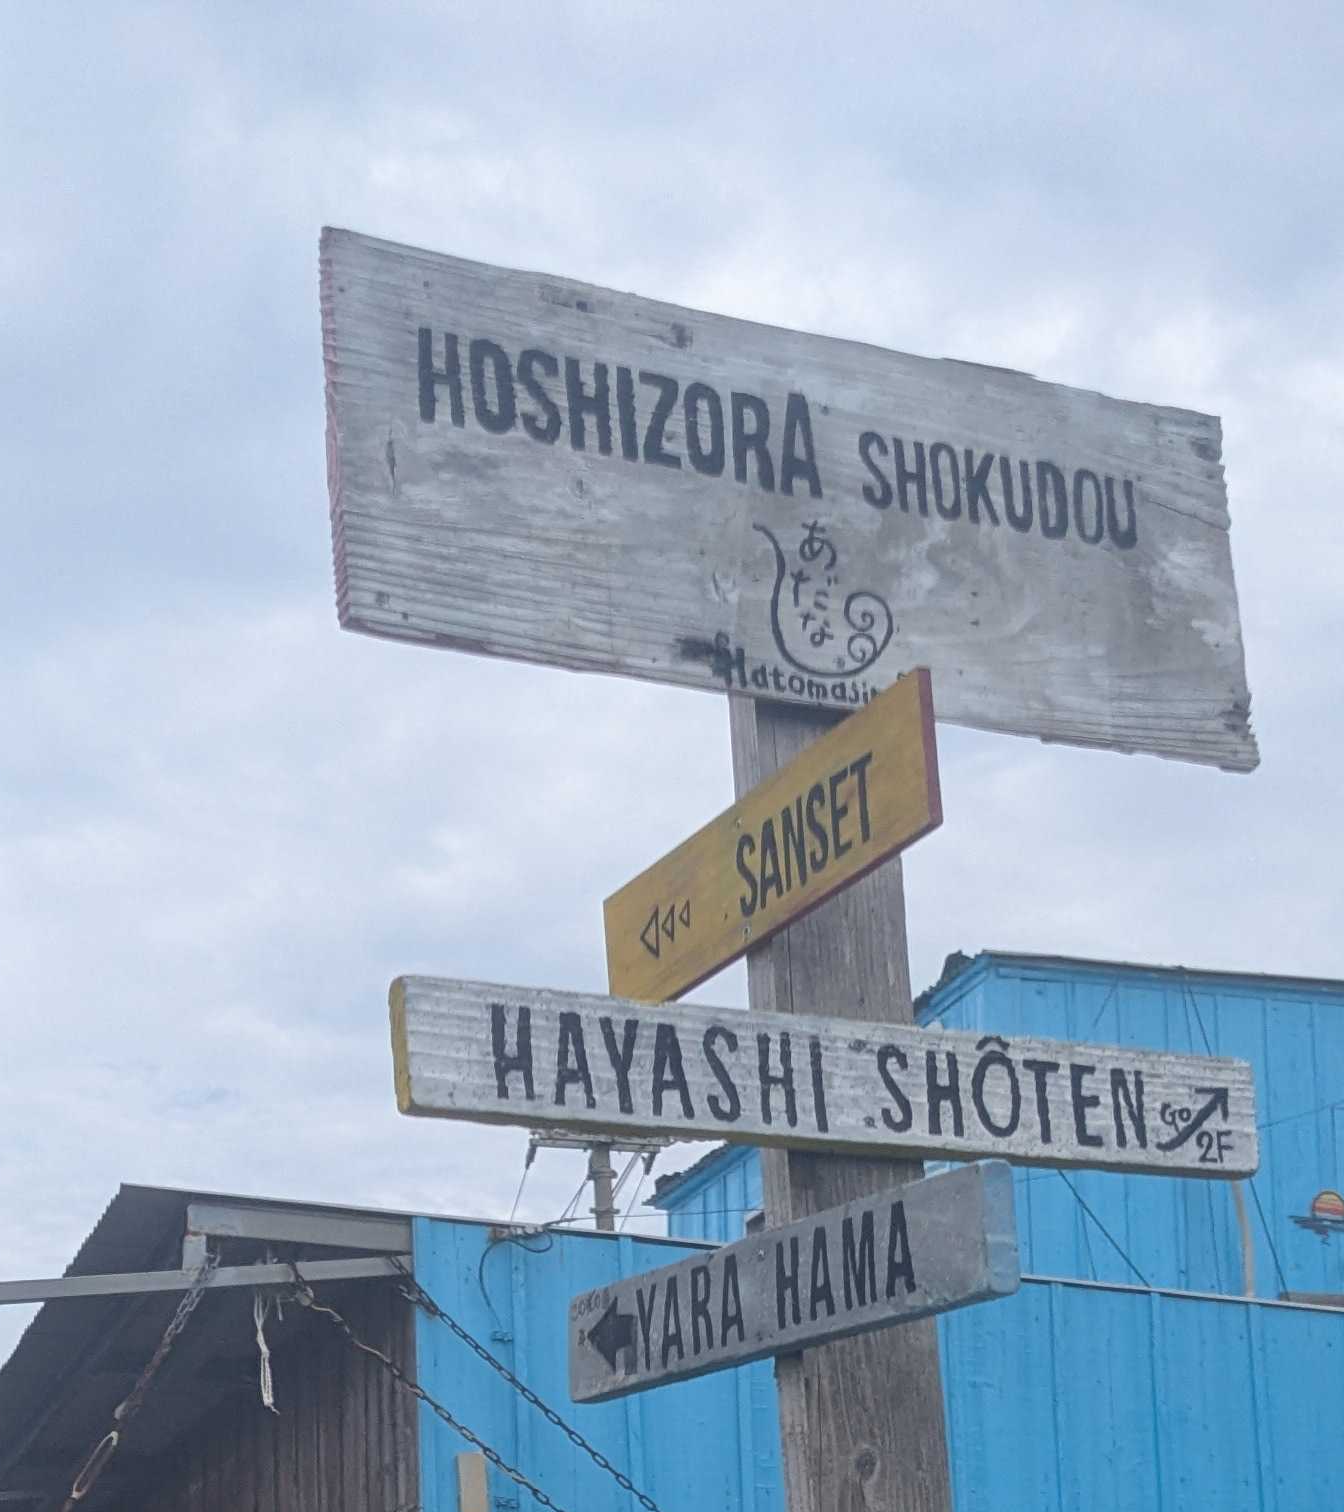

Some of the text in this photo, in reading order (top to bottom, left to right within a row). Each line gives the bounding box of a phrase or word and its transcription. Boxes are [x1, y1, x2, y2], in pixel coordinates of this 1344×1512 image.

[416, 326, 1140, 550] HOSHIZORA SHOKUDOU
[734, 751, 874, 918] SANSET
[489, 1002, 829, 1134] HAYASHI
[1195, 1130, 1235, 1164] 2F
[635, 1200, 918, 1372] YARA HAMA
